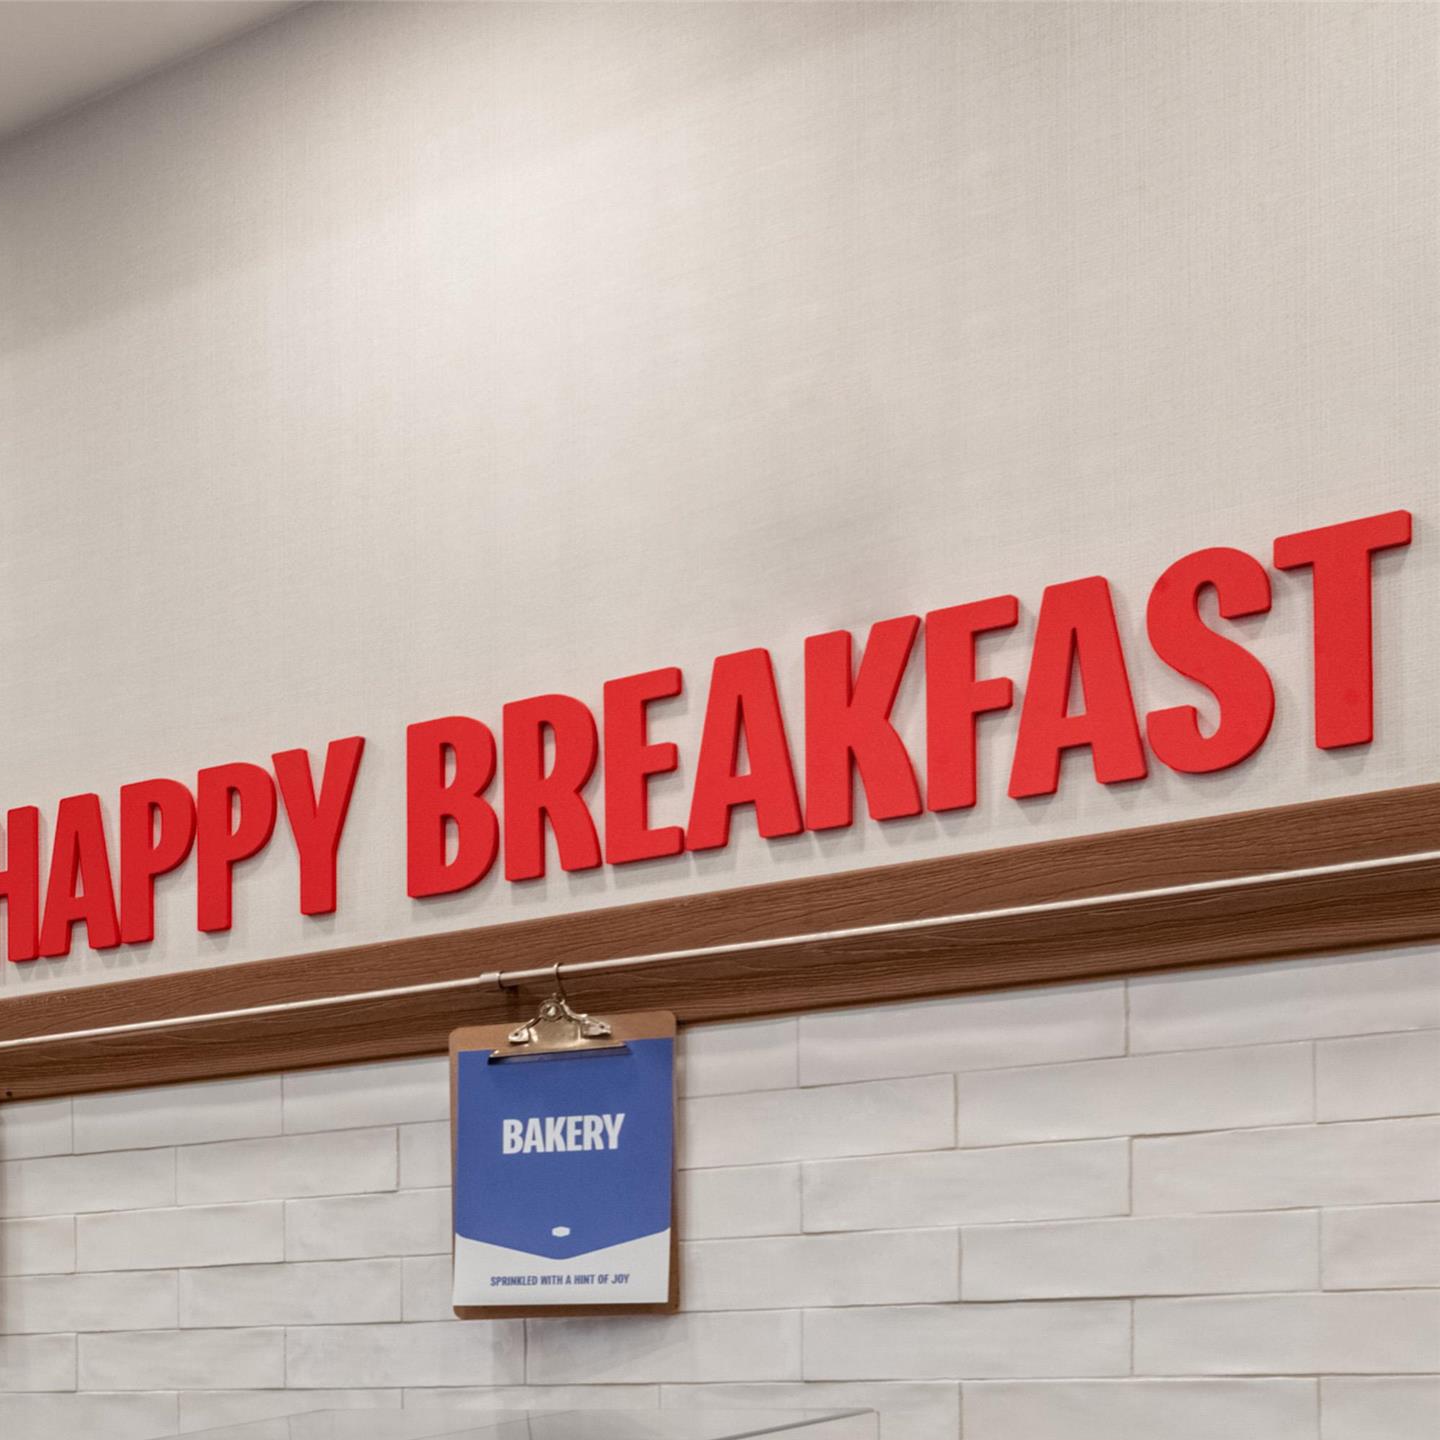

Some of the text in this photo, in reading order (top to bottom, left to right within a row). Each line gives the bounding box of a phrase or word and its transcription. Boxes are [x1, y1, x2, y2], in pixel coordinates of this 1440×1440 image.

[406, 508, 1413, 901] BREAKFAST
[502, 1113, 626, 1154] BAKERY
[490, 1273, 630, 1287] SPRINKLED WITH A HINT OF JOY
